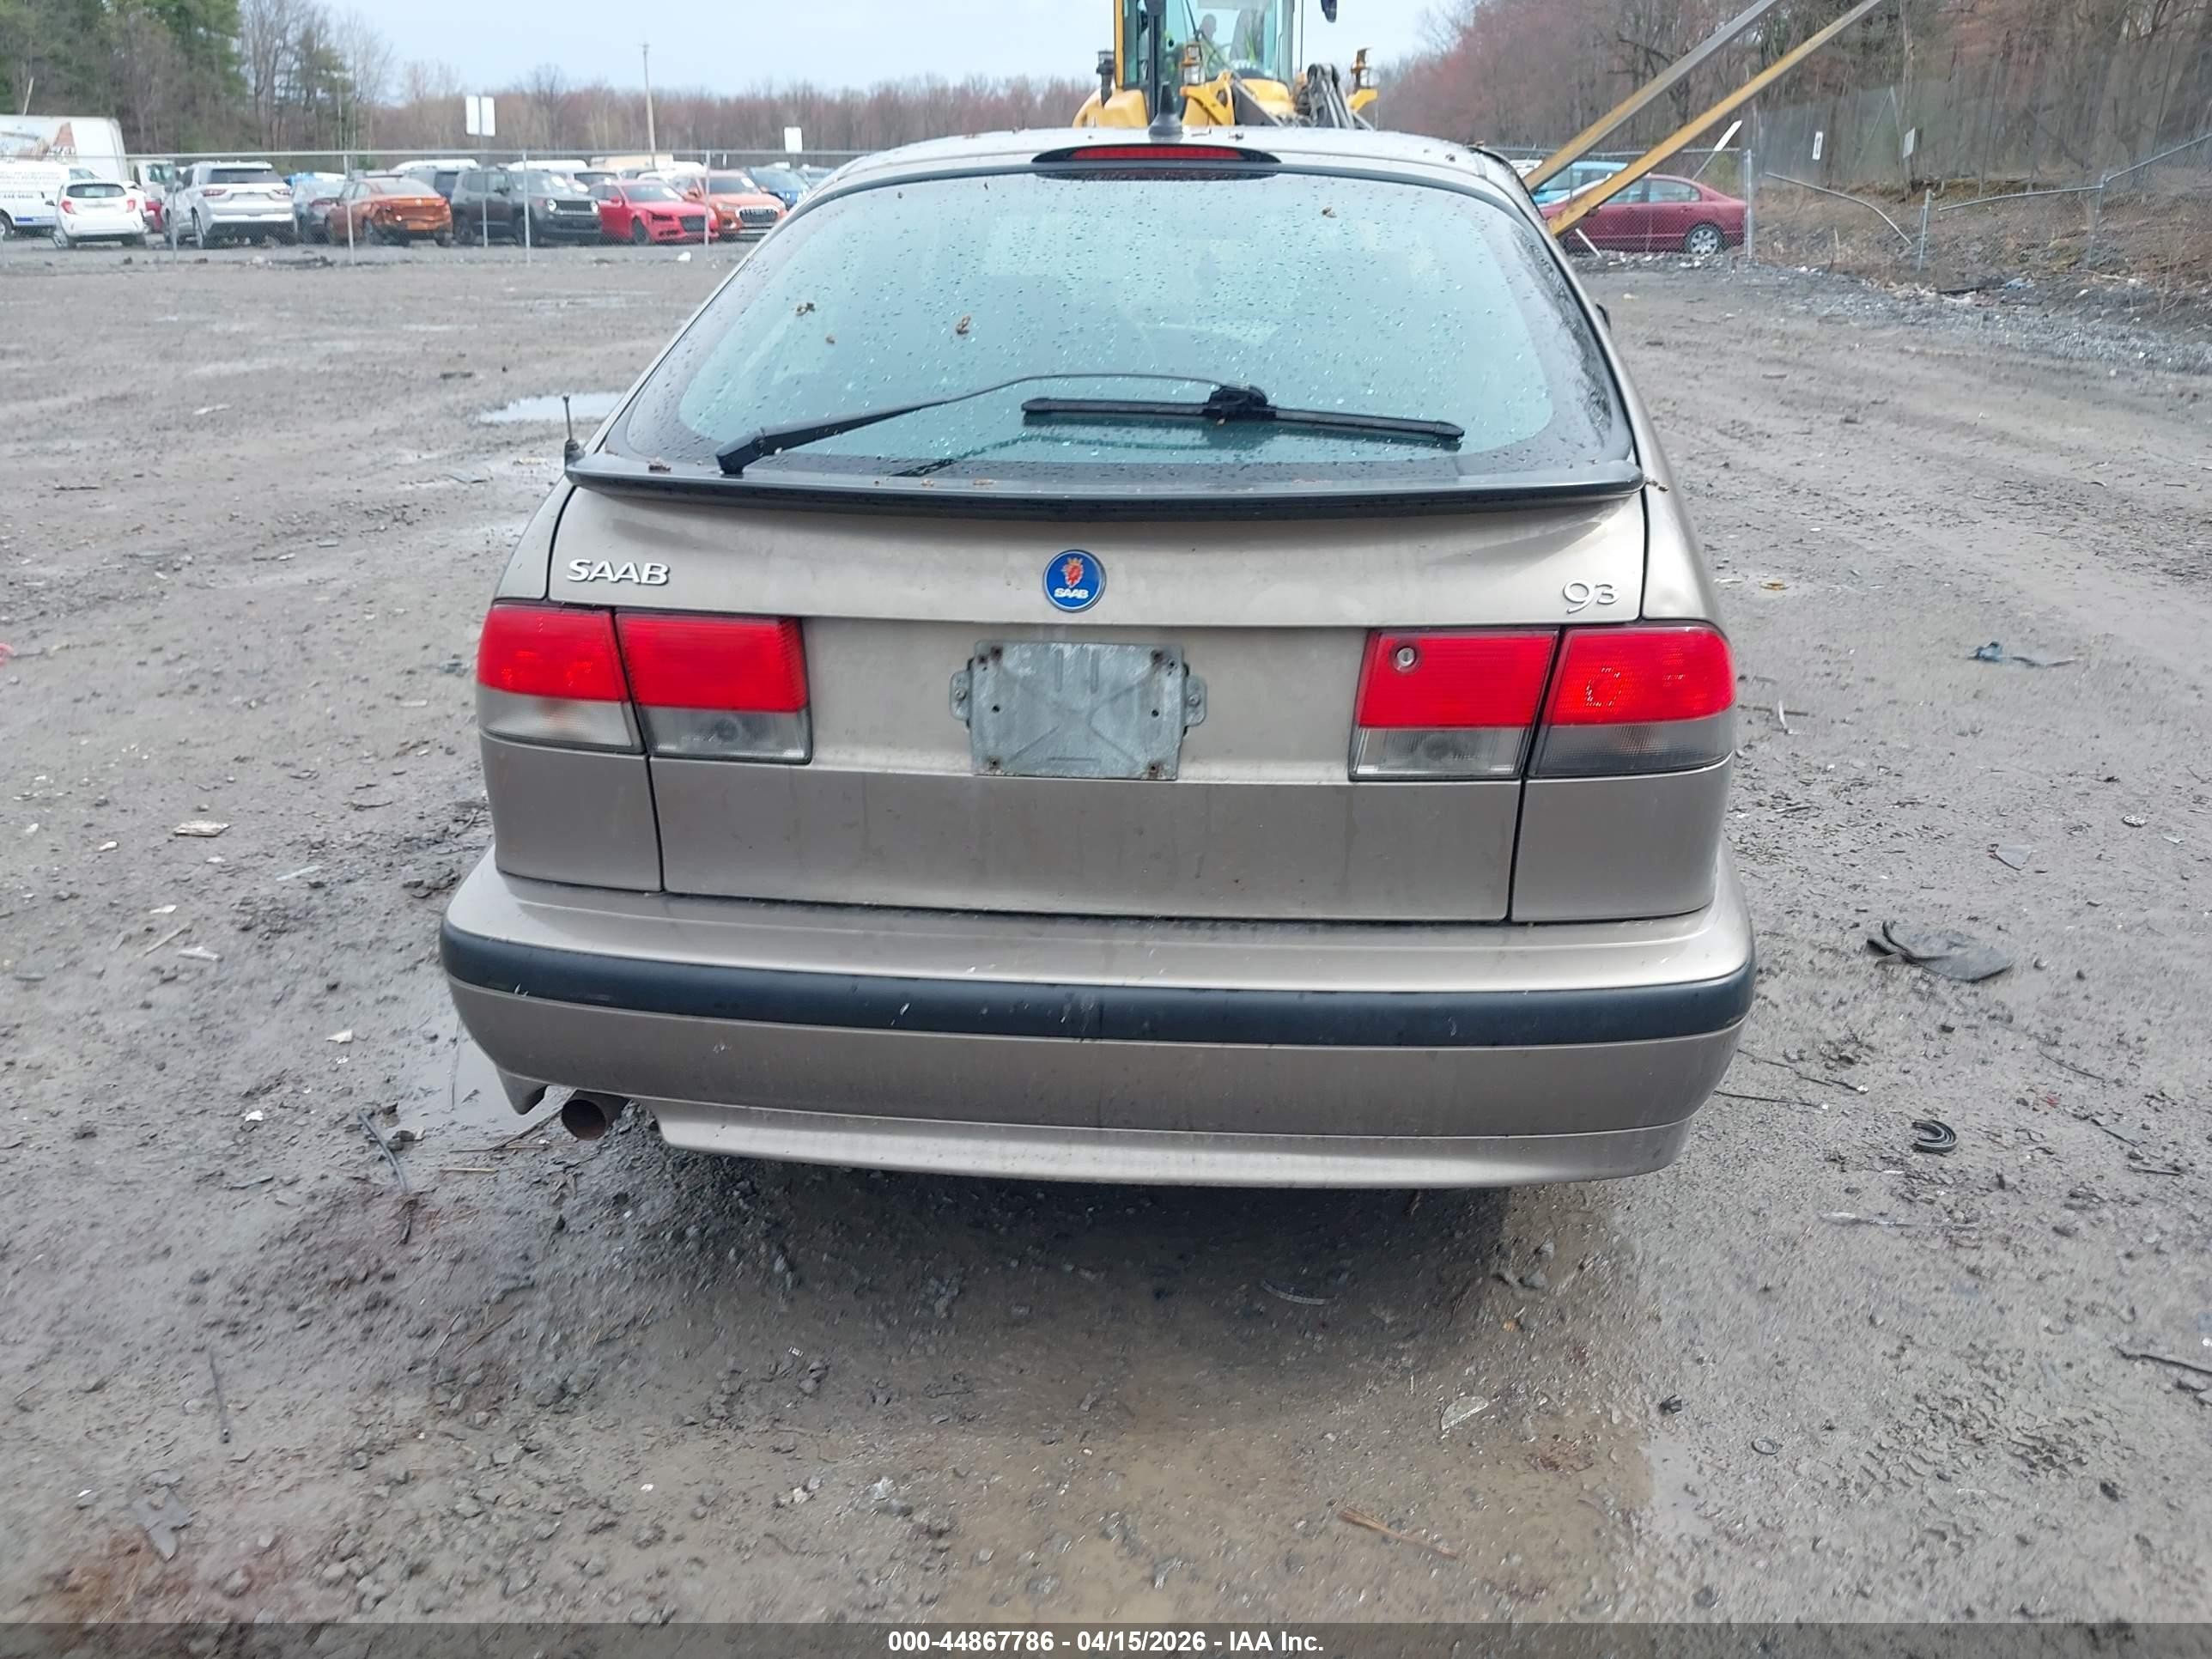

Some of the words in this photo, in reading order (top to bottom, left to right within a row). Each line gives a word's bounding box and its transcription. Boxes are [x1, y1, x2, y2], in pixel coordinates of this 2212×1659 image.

[567, 558, 670, 586] SAAB
[1054, 587, 1089, 599] SAAB
[1563, 580, 1620, 614] 93
